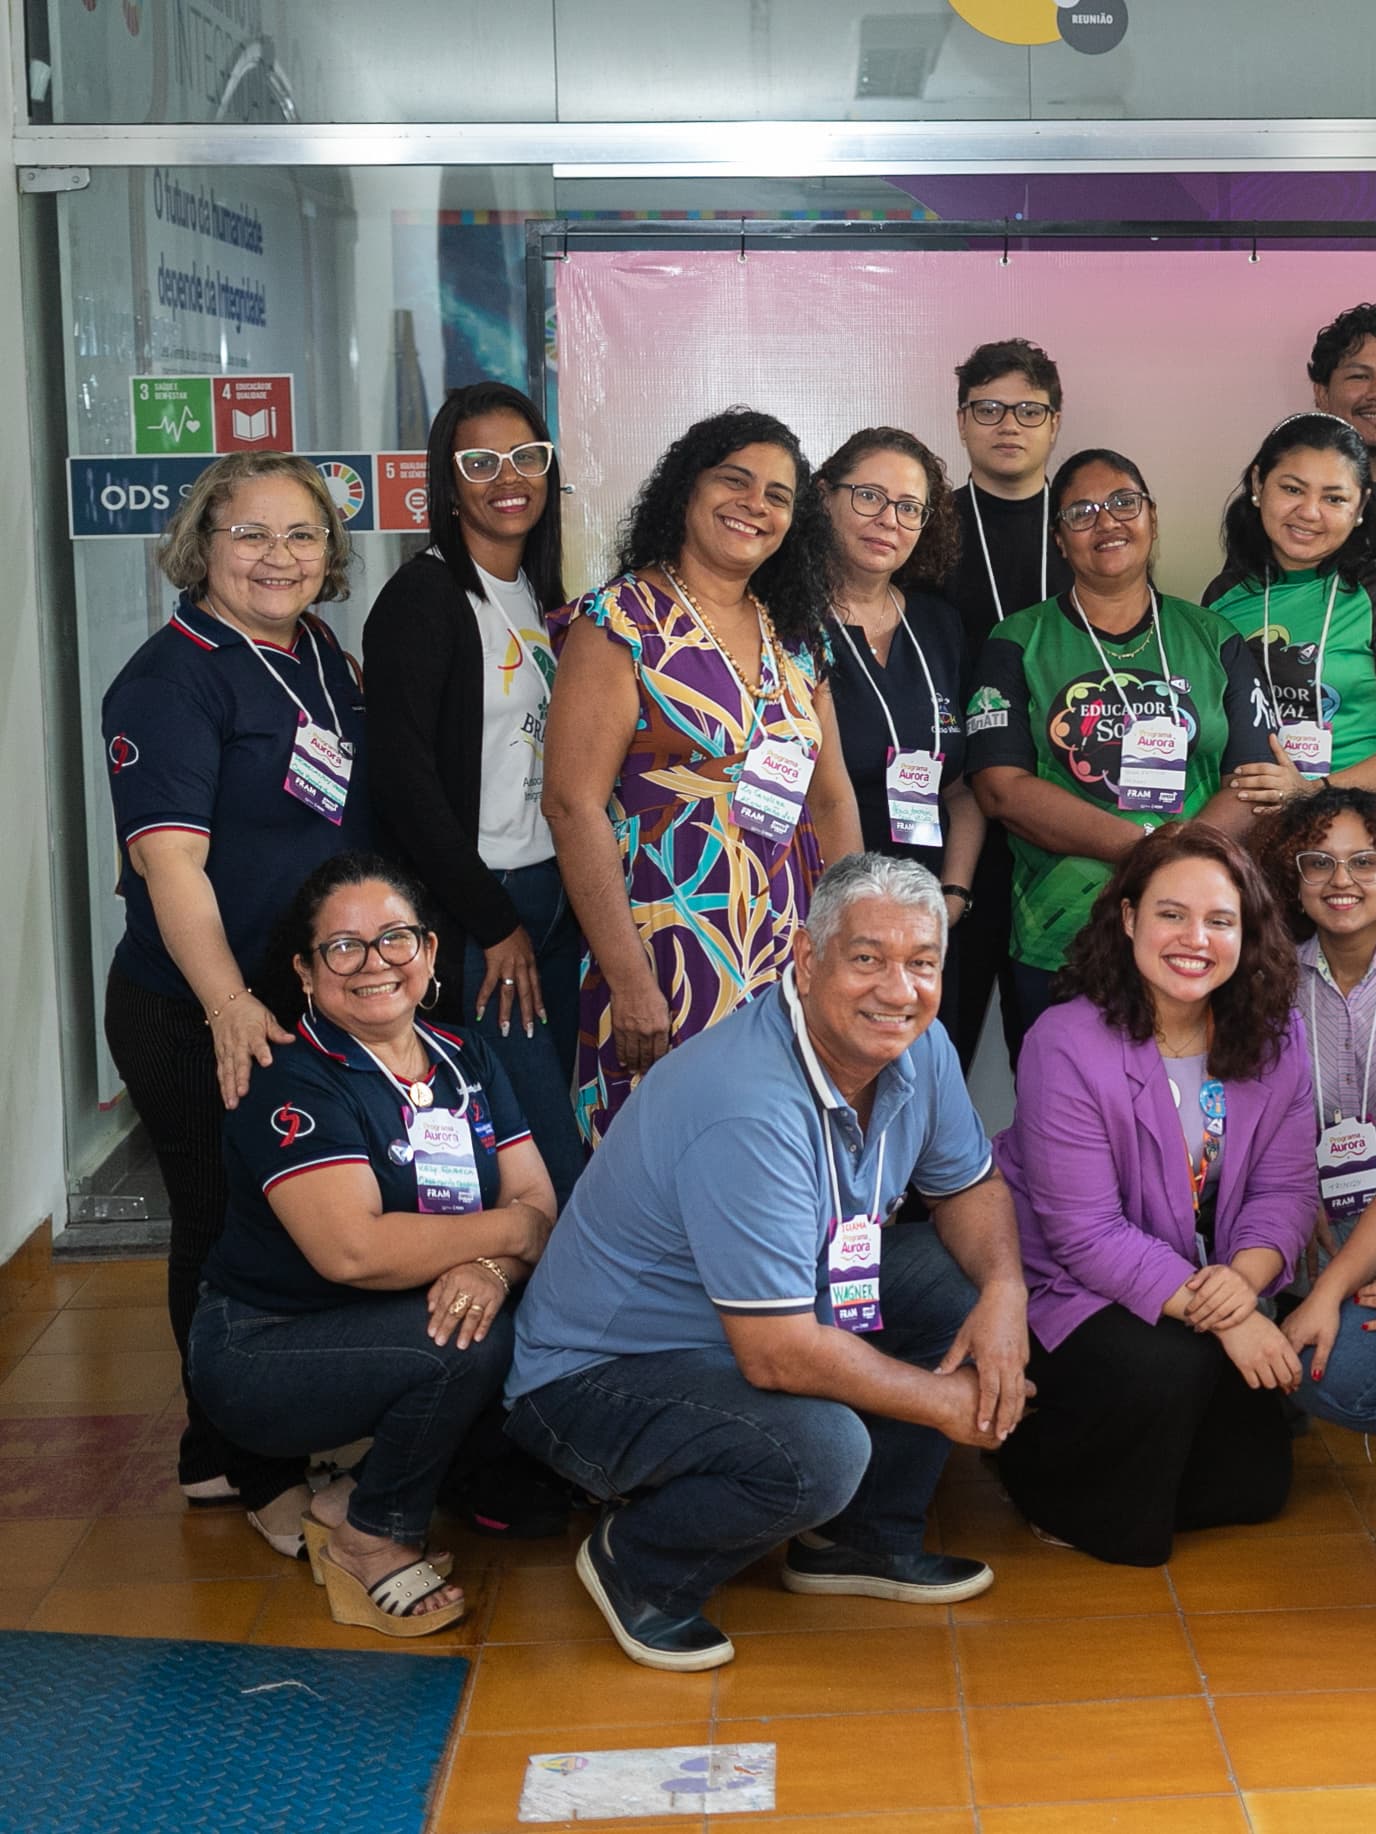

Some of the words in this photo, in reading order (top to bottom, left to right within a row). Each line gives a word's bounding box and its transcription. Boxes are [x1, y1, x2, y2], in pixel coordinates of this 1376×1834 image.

[1071, 12, 1113, 24] REUNIÃO
[165, 168, 197, 231] futuro
[198, 184, 210, 236] da
[158, 251, 203, 322] depende
[205, 265, 217, 316] da
[139, 383, 149, 400] 3
[222, 383, 231, 400] 4
[385, 462, 395, 479] 5
[101, 485, 170, 510] ODS
[1080, 701, 1166, 717] EDUCADOR
[1137, 736, 1175, 747] Aurora
[1284, 740, 1319, 751] Aurora
[311, 737, 342, 765] Aurora
[762, 756, 800, 778] Aurora
[899, 769, 930, 782] Aurora
[295, 777, 317, 796] FRAM
[1127, 789, 1151, 798] FRAM
[741, 806, 765, 823] FRAM
[896, 822, 914, 831] FRAM
[424, 1129, 459, 1142] Aurora
[1330, 1139, 1366, 1154] Aurora
[427, 1188, 451, 1199] FRAM
[1332, 1195, 1355, 1208] FRAM
[841, 1241, 871, 1254] Aurora
[833, 1284, 874, 1304] WAGNER
[839, 1307, 858, 1320] FRAM
